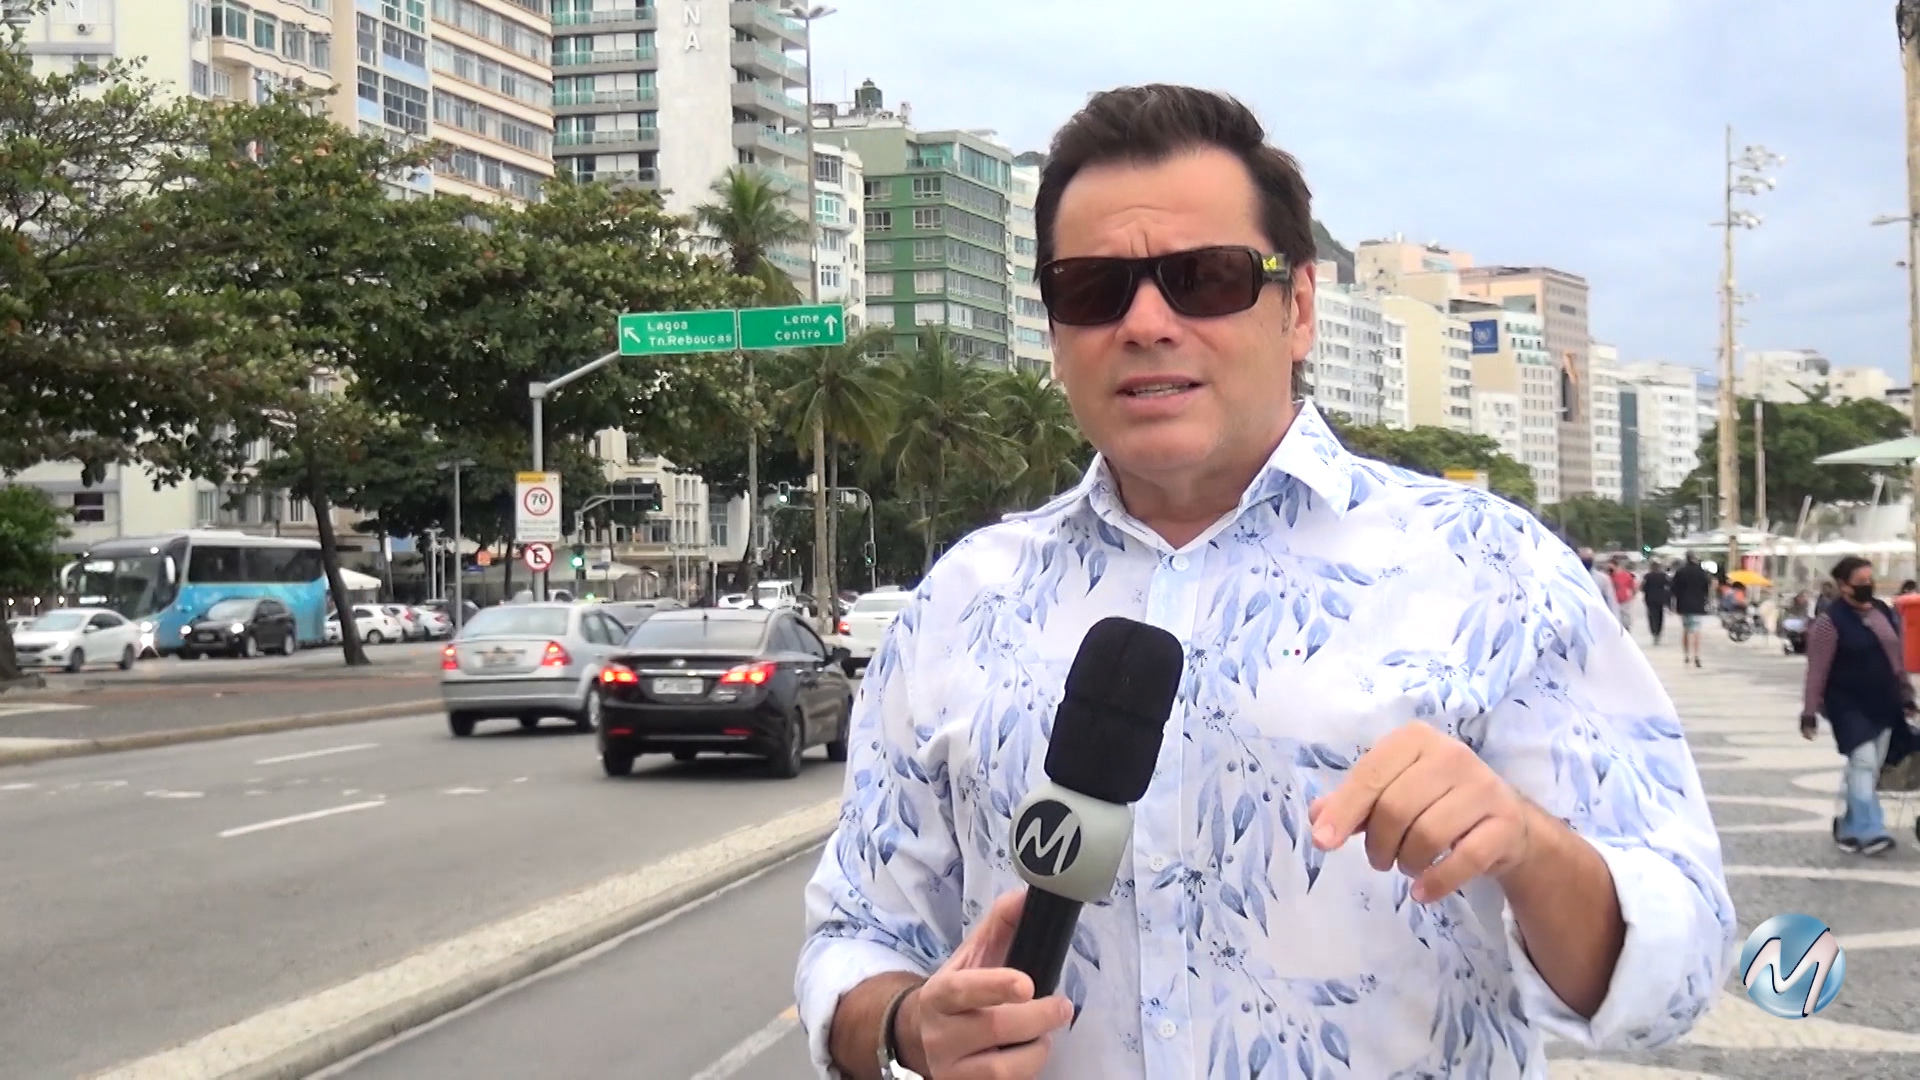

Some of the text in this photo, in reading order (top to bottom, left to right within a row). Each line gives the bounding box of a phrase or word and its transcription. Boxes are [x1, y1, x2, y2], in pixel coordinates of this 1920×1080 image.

[783, 315, 819, 325] Leme
[647, 321, 688, 334] Lagoa
[775, 330, 820, 341] Centro
[531, 493, 547, 505] 70
[1017, 811, 1080, 874] M
